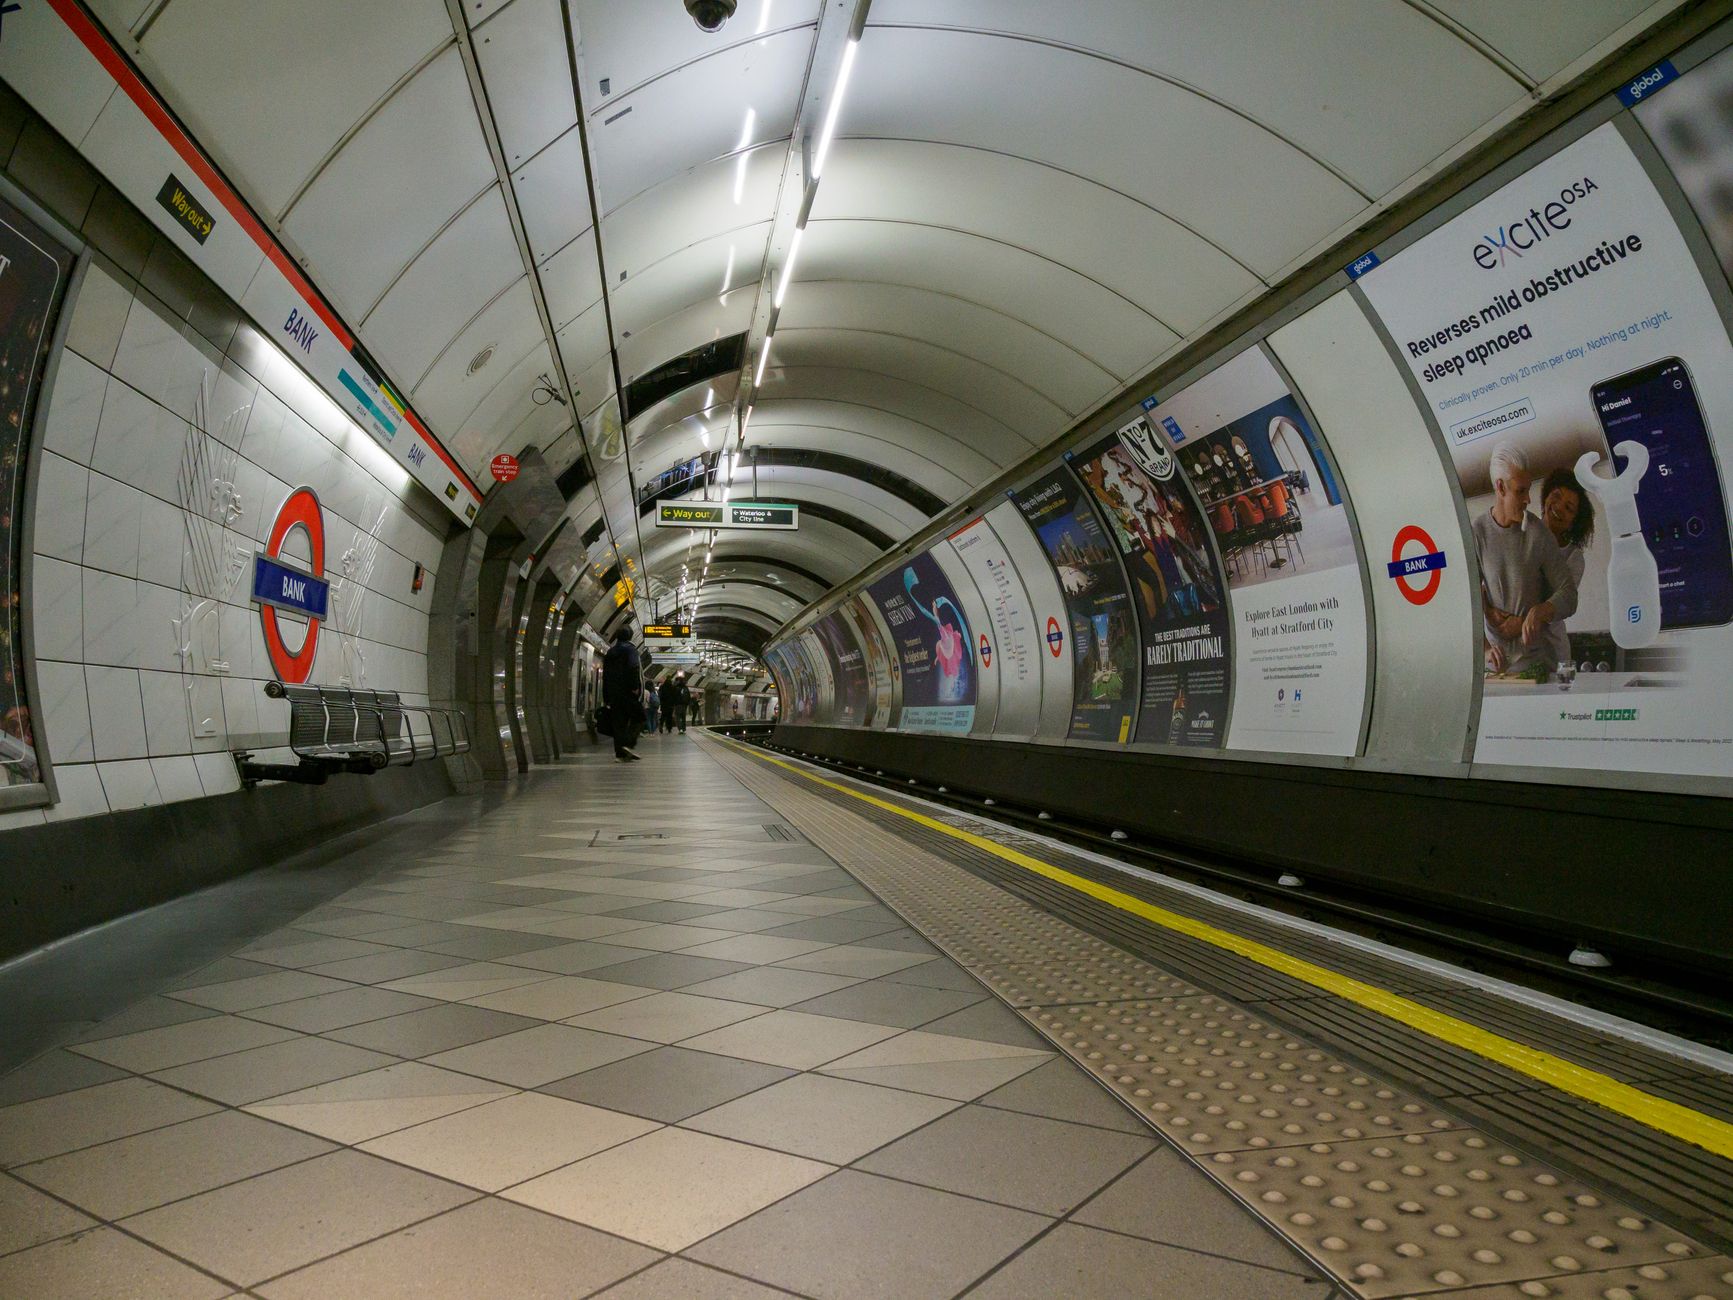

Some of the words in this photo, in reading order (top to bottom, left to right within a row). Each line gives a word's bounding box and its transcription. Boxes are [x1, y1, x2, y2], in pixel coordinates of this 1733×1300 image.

[1630, 67, 1664, 98] global
[171, 187, 191, 217] Way
[187, 210, 204, 230] out
[1353, 255, 1372, 275] global
[1406, 313, 1481, 359] Reverses
[1479, 288, 1523, 325] mild
[1522, 234, 1643, 303] obstructive
[283, 307, 319, 354] BANK
[1422, 353, 1466, 383] sleep
[1465, 322, 1533, 366] apnoea
[1438, 391, 1471, 411] Clinically
[1499, 372, 1520, 387] Only
[1518, 366, 1531, 379] 20
[1531, 357, 1550, 374] min
[1549, 354, 1564, 369] per
[1586, 328, 1628, 352] Nothing
[1627, 322, 1640, 335] at
[1640, 310, 1673, 329] night.
[1601, 404, 1610, 413] Hi
[1609, 396, 1632, 409] Daniel
[1456, 406, 1529, 439] uk.exciteosa.com
[407, 442, 427, 469] BANK
[1148, 457, 1171, 474] BRAND
[672, 509, 693, 519] Way
[694, 510, 711, 519] out
[1404, 558, 1428, 572] BANK
[282, 575, 306, 603] BANK
[1245, 609, 1271, 624] Explore
[1271, 606, 1288, 618] East
[1288, 601, 1319, 616] London
[1319, 597, 1339, 611] with
[1154, 632, 1164, 642] THE
[1163, 629, 1175, 641] BEST
[1174, 625, 1200, 639] TRADITIONS
[1200, 623, 1211, 635] ARE
[1251, 625, 1269, 640] Hyatt
[1271, 624, 1279, 636] at
[1280, 618, 1316, 635] Stratford
[1317, 617, 1335, 632] City
[1146, 643, 1173, 666] RARELY
[1567, 712, 1592, 721] Trustpilot
